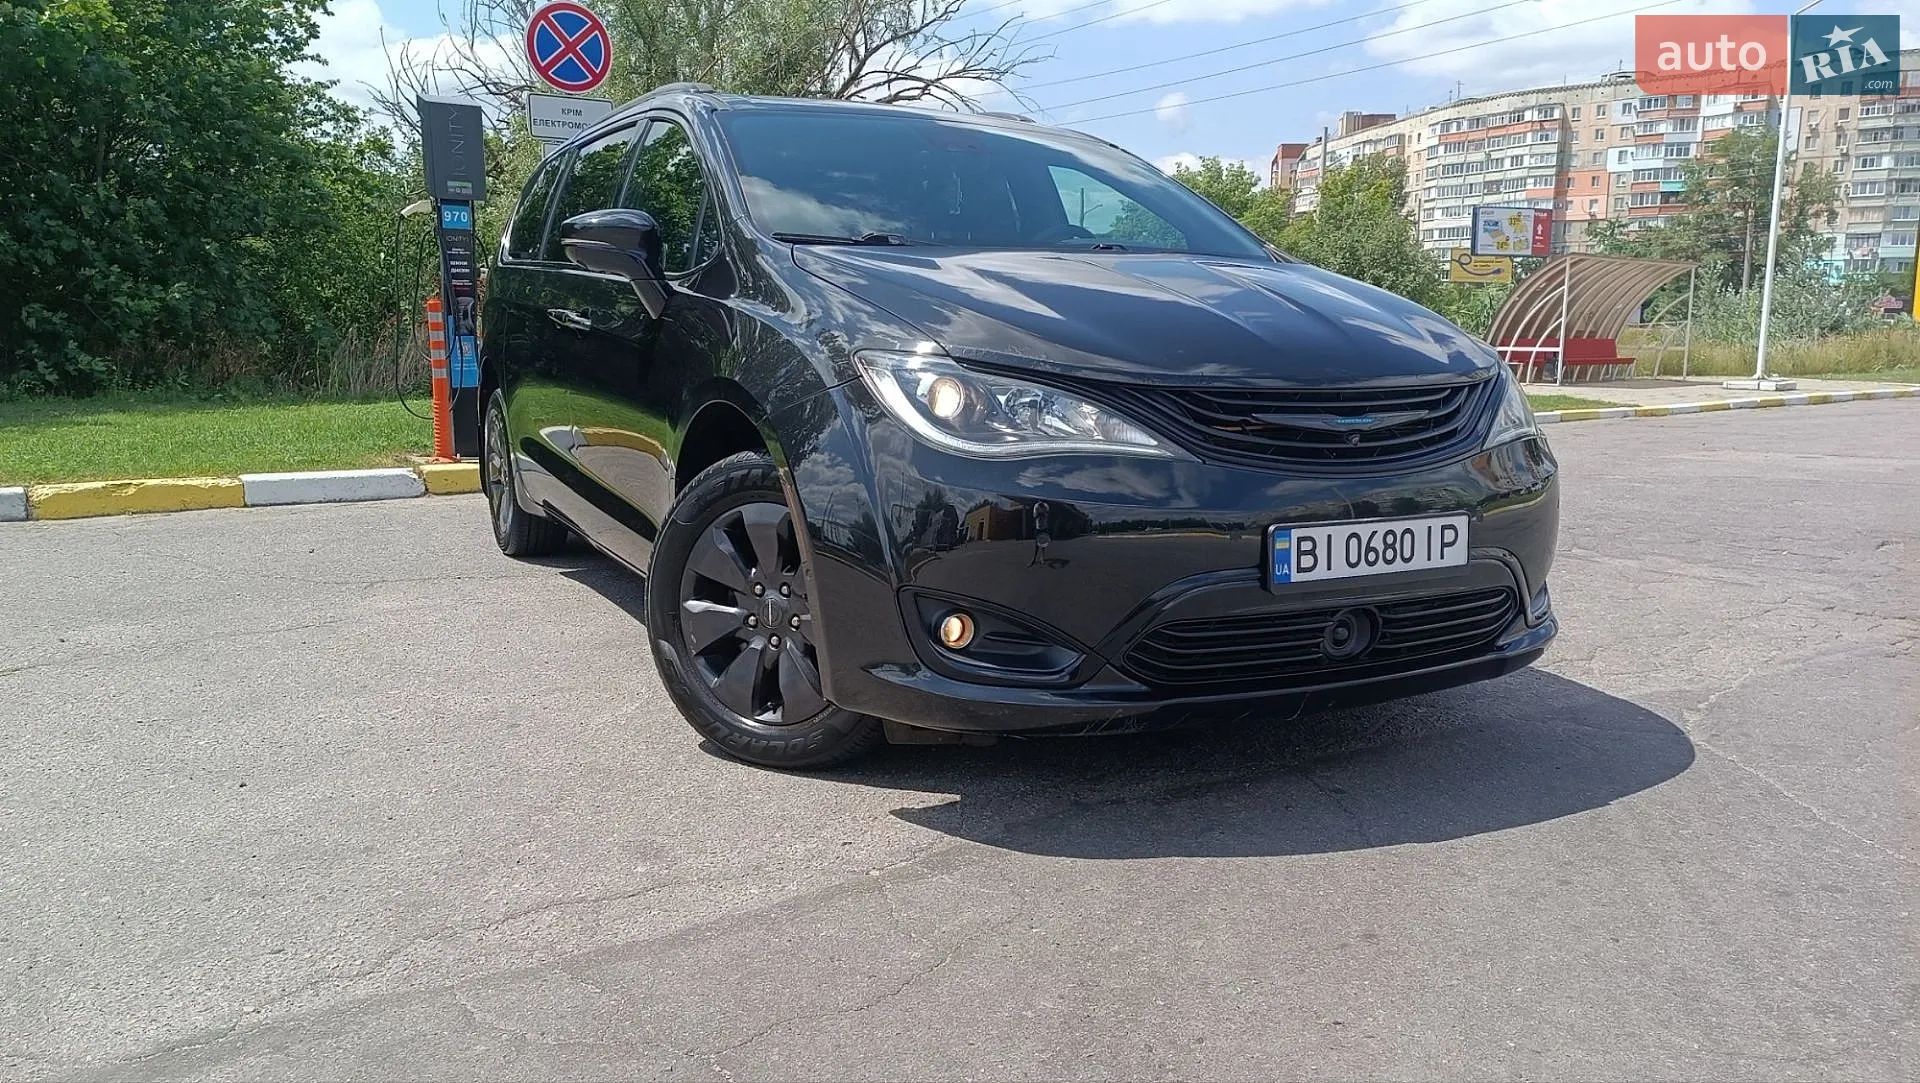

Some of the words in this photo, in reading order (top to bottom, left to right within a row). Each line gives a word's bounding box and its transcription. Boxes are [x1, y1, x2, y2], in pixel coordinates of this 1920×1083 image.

[561, 107, 583, 117] КРІМ
[533, 118, 591, 130] ЕЛЕКТРОМО
[444, 210, 468, 222] 970
[1345, 527, 1416, 569] 0680
[1275, 563, 1289, 575] UA
